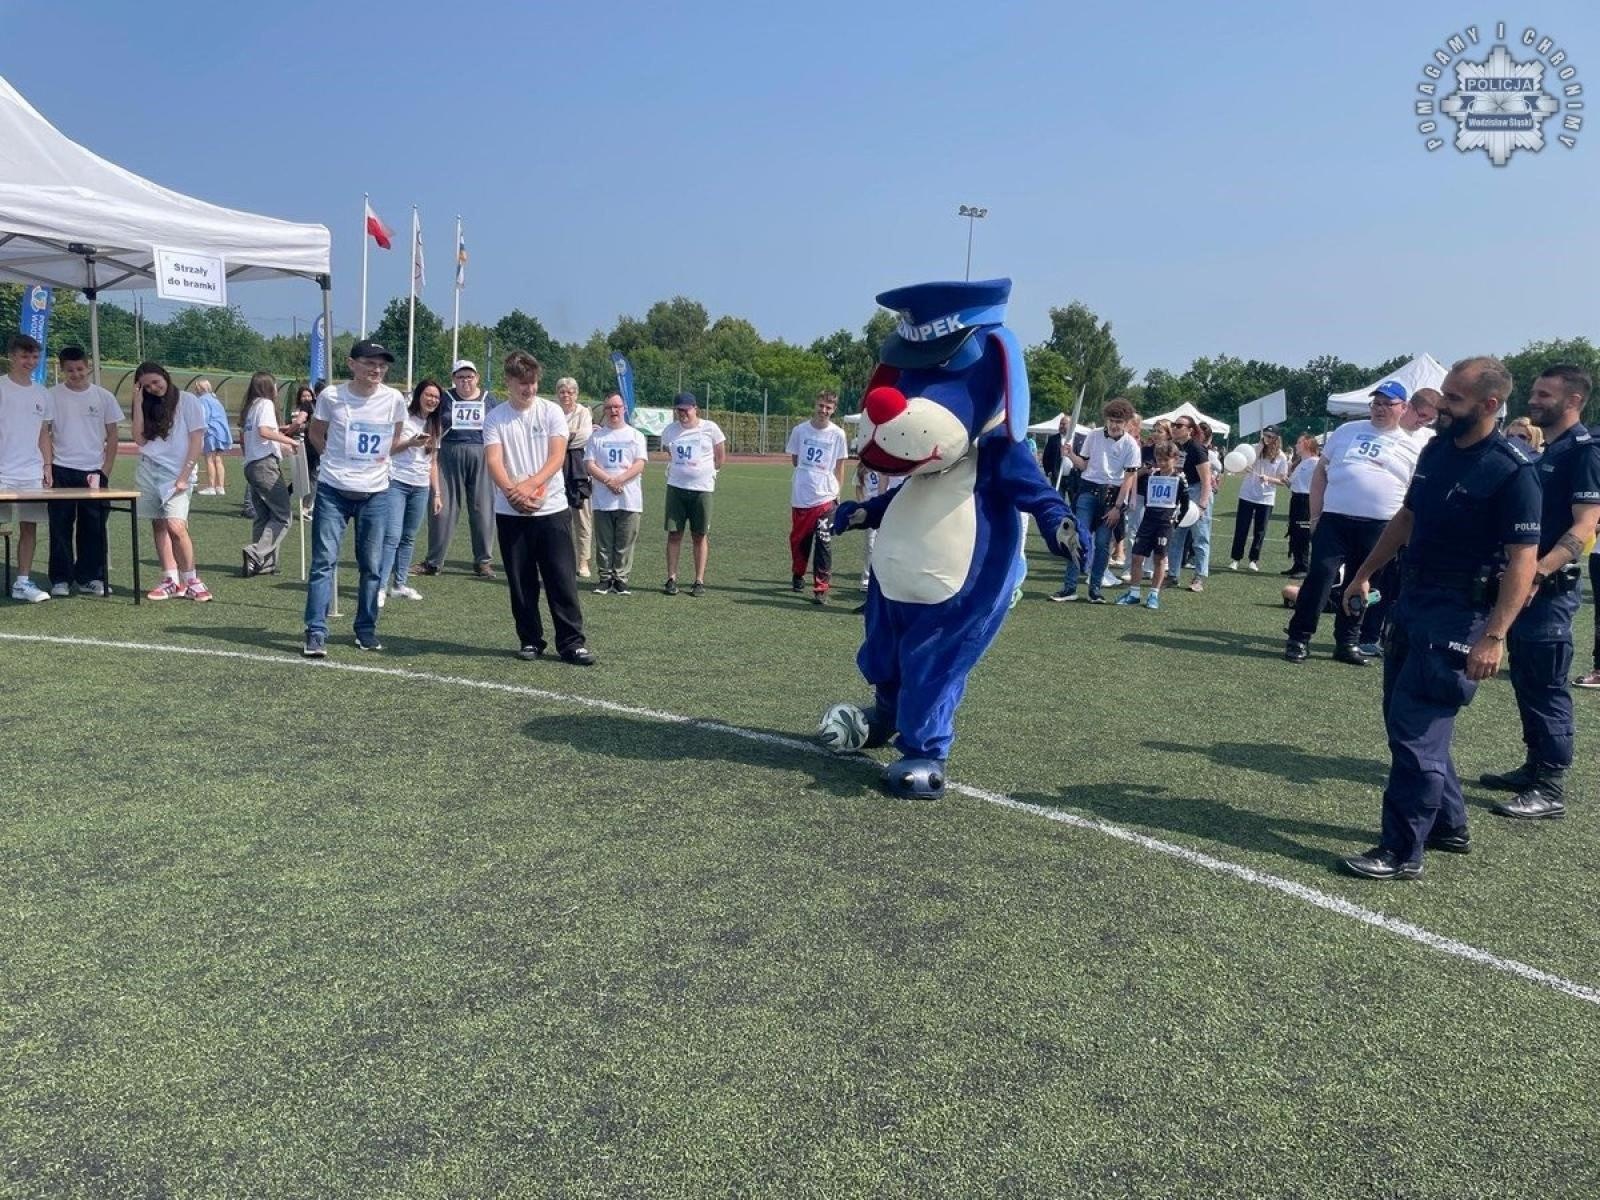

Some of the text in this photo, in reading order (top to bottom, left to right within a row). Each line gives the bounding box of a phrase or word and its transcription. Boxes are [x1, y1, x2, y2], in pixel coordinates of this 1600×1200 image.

[174, 262, 208, 277] Strzały
[168, 276, 216, 291] do bramki
[456, 409, 480, 420] 476
[358, 433, 381, 454] 82
[1358, 442, 1382, 457] 95
[609, 448, 623, 462] 91
[677, 446, 692, 459] 94
[807, 447, 823, 463] 92
[1152, 485, 1171, 498] 104
